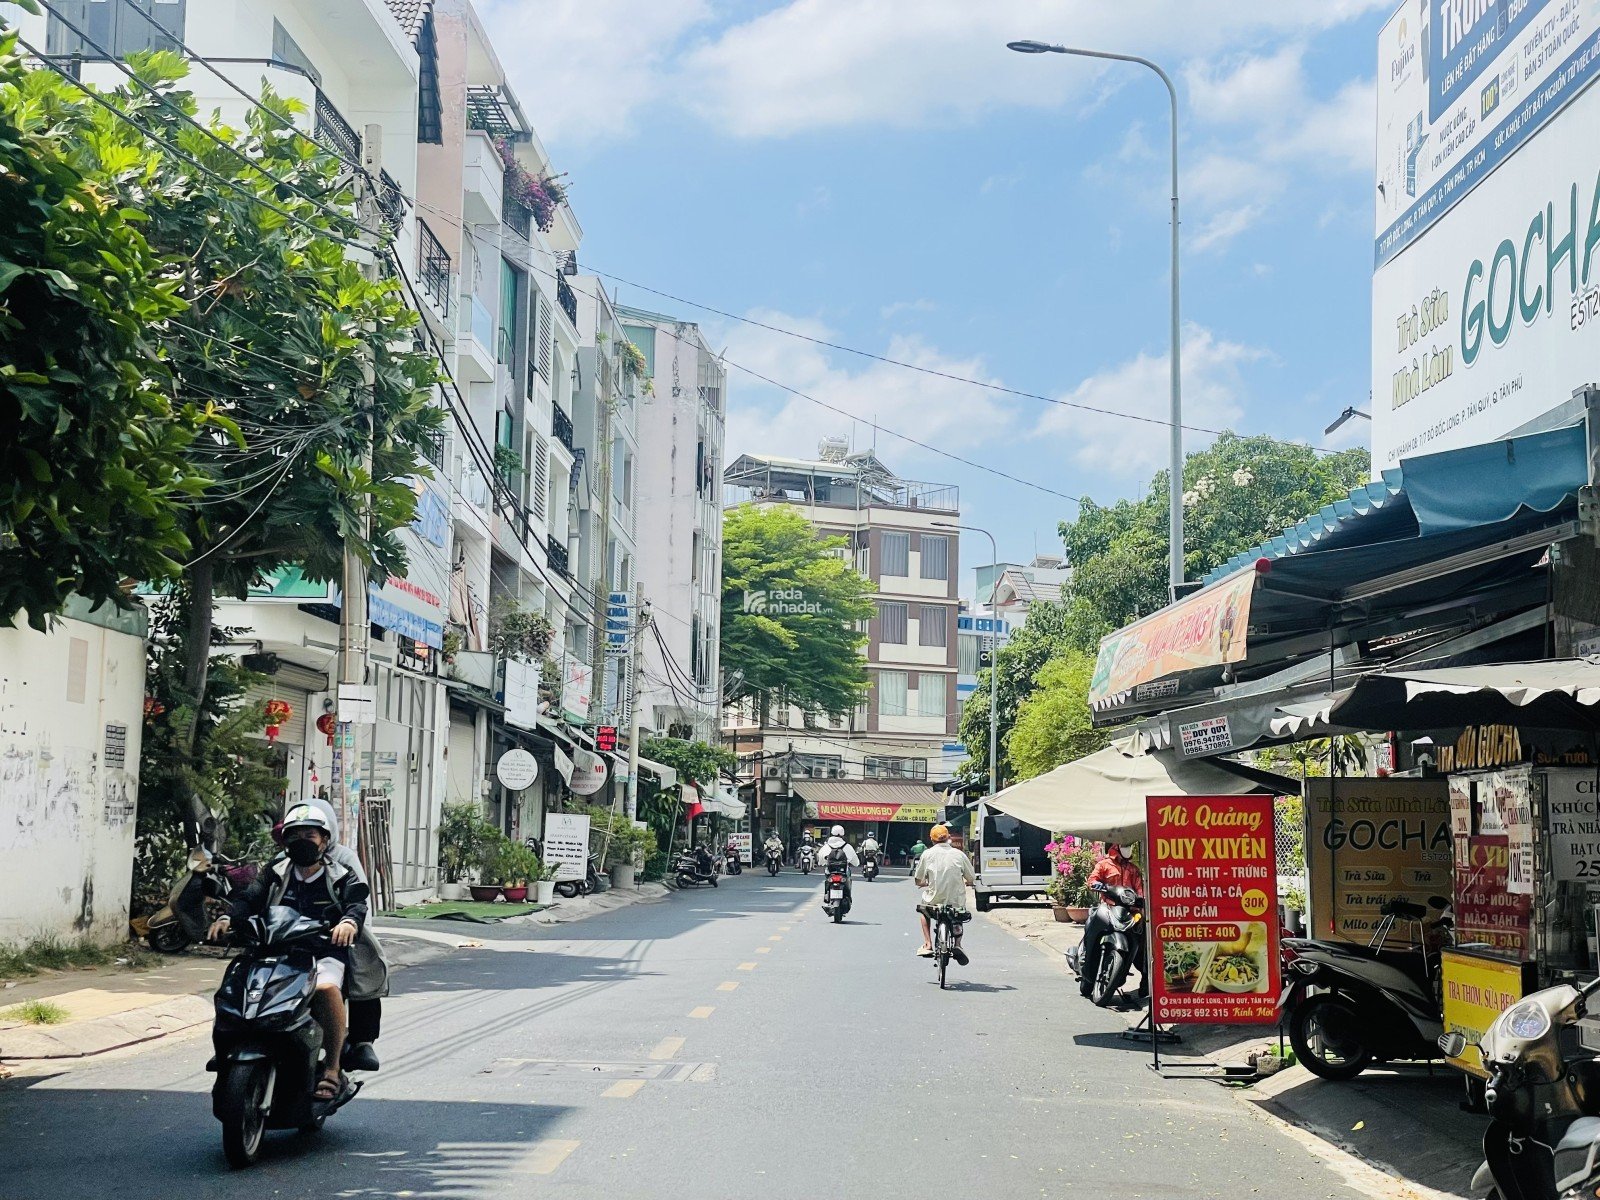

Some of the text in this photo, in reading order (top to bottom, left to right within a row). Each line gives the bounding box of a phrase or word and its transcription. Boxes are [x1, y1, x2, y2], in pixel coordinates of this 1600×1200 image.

[1544, 16, 1555, 38] CTV
[1442, 75, 1454, 96] LIÊN
[1477, 26, 1495, 59] HÀNG
[1524, 60, 1537, 81] BÁN
[1545, 36, 1561, 61] TOÀN
[1482, 82, 1498, 115] 100%
[1455, 134, 1465, 155] CAO
[1474, 148, 1486, 170] HCM
[1397, 304, 1418, 354] Trà
[1392, 344, 1453, 411] Nhà Làm
[1500, 383, 1511, 401] TÂN
[1193, 729, 1208, 738] DUY
[1478, 725, 1522, 768] GOCHA
[1552, 799, 1594, 814] KHÚC
[1158, 804, 1263, 832] Mì Quảng
[1552, 819, 1575, 835] TRÀ
[1323, 819, 1453, 851] GOCHA
[1157, 833, 1266, 860] DUY XUYÊN
[1571, 843, 1594, 858] HẠT
[1160, 865, 1184, 879] TÔM
[1196, 866, 1220, 881] THỊT
[1231, 864, 1268, 878] TRỨNG
[1344, 870, 1361, 881] Trà
[1414, 870, 1432, 881] Trà
[1162, 884, 1243, 899] SƯỜN CÁ
[1345, 894, 1363, 904] Trà
[1366, 894, 1386, 905] trái
[1162, 901, 1218, 920] THẬP CẨM
[1244, 897, 1265, 908] 30K
[1161, 925, 1236, 940] ĐẶC BIỆT: 40K
[1343, 920, 1368, 930] Milo
[1171, 1006, 1274, 1018] 0932 692 315 Kính Mời
